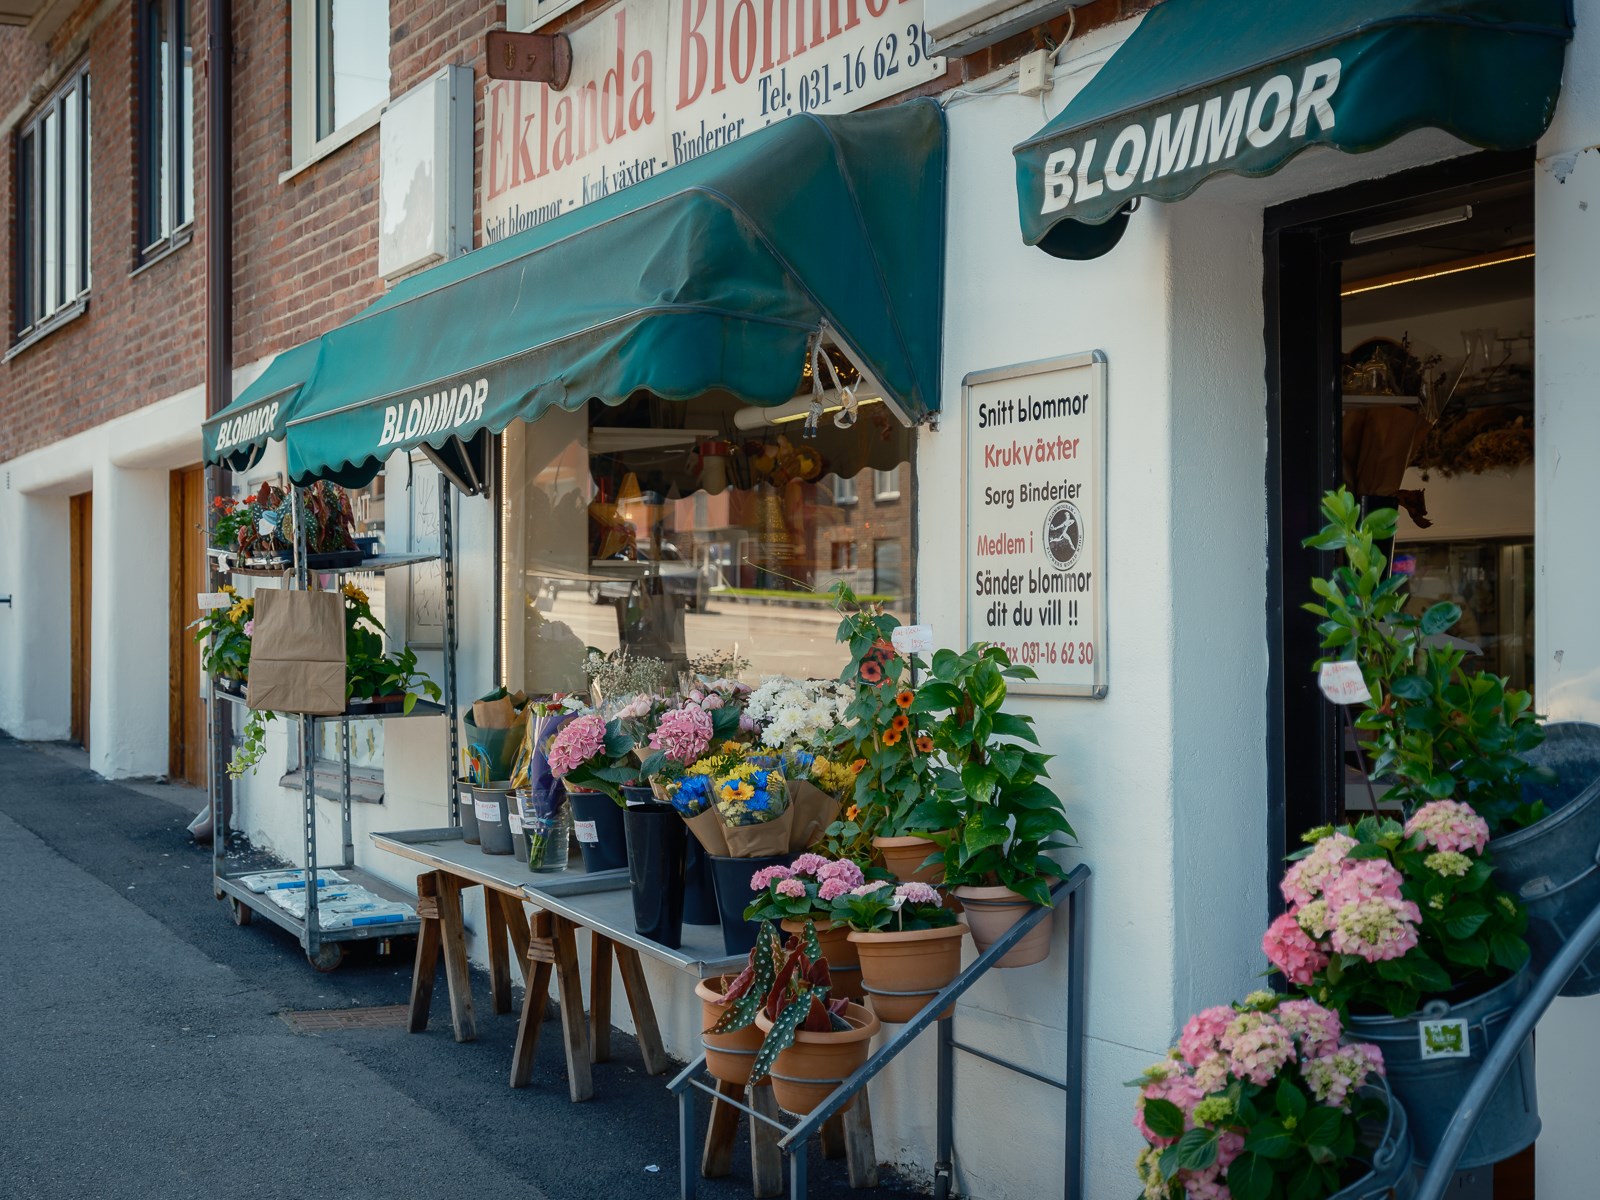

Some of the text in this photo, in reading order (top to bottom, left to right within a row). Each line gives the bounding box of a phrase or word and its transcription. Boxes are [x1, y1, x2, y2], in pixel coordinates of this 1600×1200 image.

[758, 68, 792, 117] Tel:
[799, 45, 866, 113] 031-16
[873, 32, 899, 81] 62
[487, 0, 912, 201] Eklanda Blom
[1040, 57, 1341, 215] BLOMMOR
[486, 216, 505, 245] Snitt
[509, 204, 562, 236] blommor
[582, 166, 609, 206] Kruk
[612, 157, 656, 191] växter
[672, 113, 744, 166] Binderier
[215, 402, 279, 451] BLOMMOR
[377, 378, 488, 447] BLOMMOR
[979, 394, 1088, 428] Snitt blommor
[985, 435, 1079, 468] Krukväxter
[985, 479, 1081, 509] Sorg Binderier
[977, 533, 1025, 556] Medlem
[976, 567, 1091, 596] Sänder blommor
[987, 601, 1007, 626] dit
[1013, 600, 1032, 626] du
[1039, 599, 1061, 626] vill
[1022, 641, 1057, 664] 031-16
[1061, 641, 1074, 664] 62
[1078, 641, 1093, 664] 30
